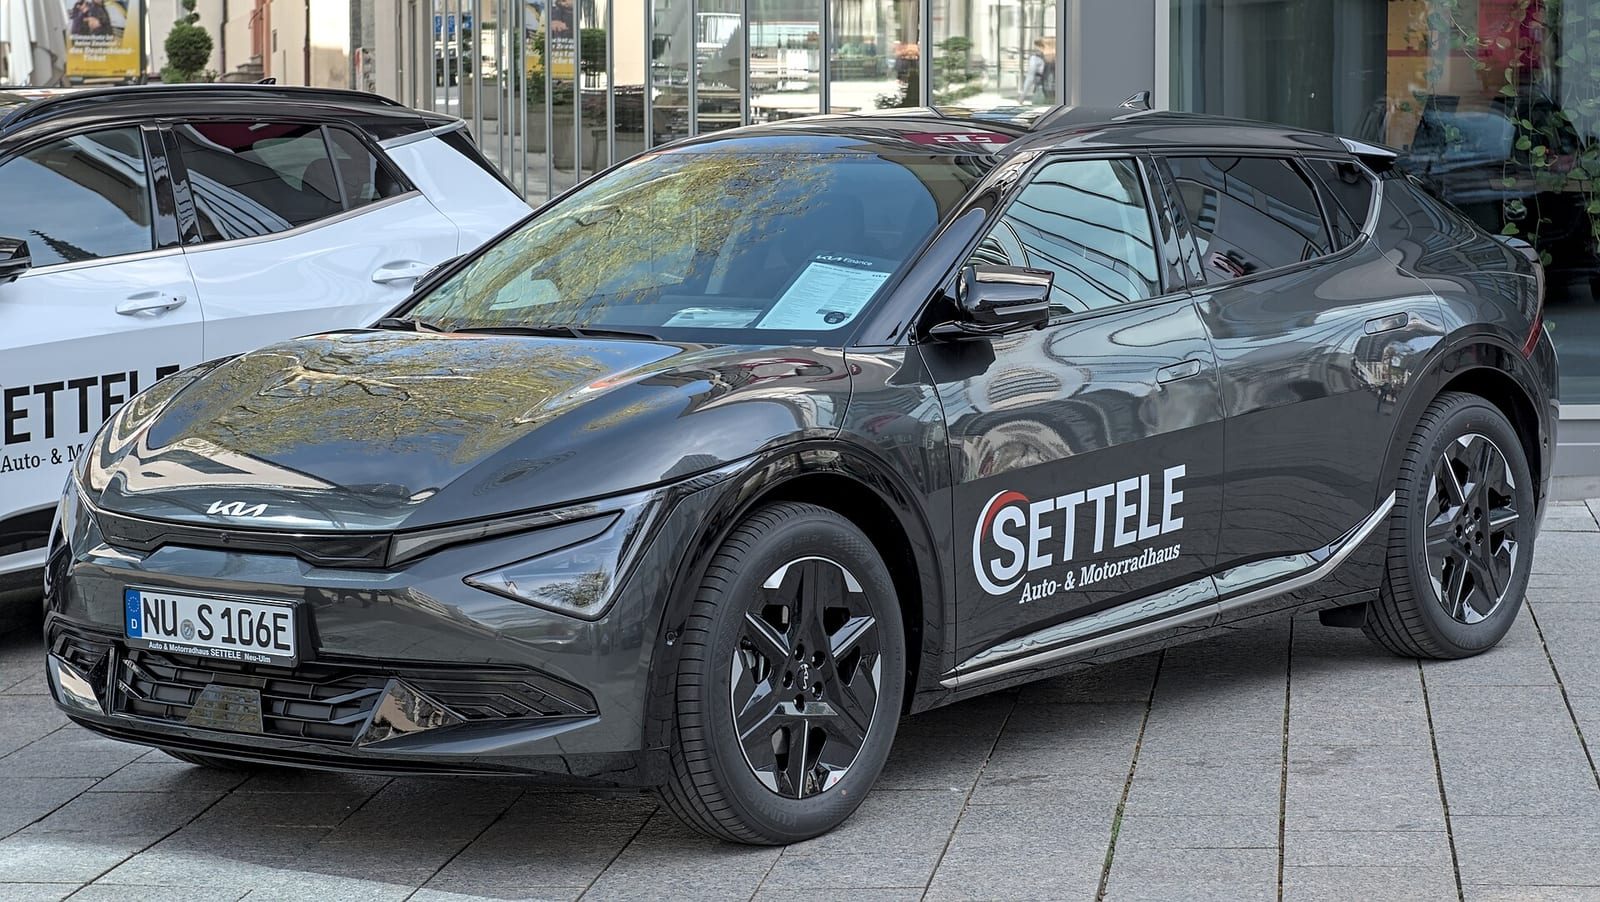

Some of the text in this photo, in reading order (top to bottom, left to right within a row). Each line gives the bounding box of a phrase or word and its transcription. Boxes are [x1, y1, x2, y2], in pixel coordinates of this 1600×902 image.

[843, 257, 873, 266] Finance
[4, 364, 180, 445] ETTE
[0, 453, 46, 473] Auto-
[51, 448, 63, 465] &
[206, 500, 268, 517] KIA
[990, 464, 1186, 581] SETTELE
[1019, 544, 1181, 604] Auto- & Motorradhaus
[131, 619, 137, 629] D
[143, 597, 291, 651] NU S 106E
[148, 641, 271, 664] Auto & Motorradhaus SETTELE Neu-Ulm
